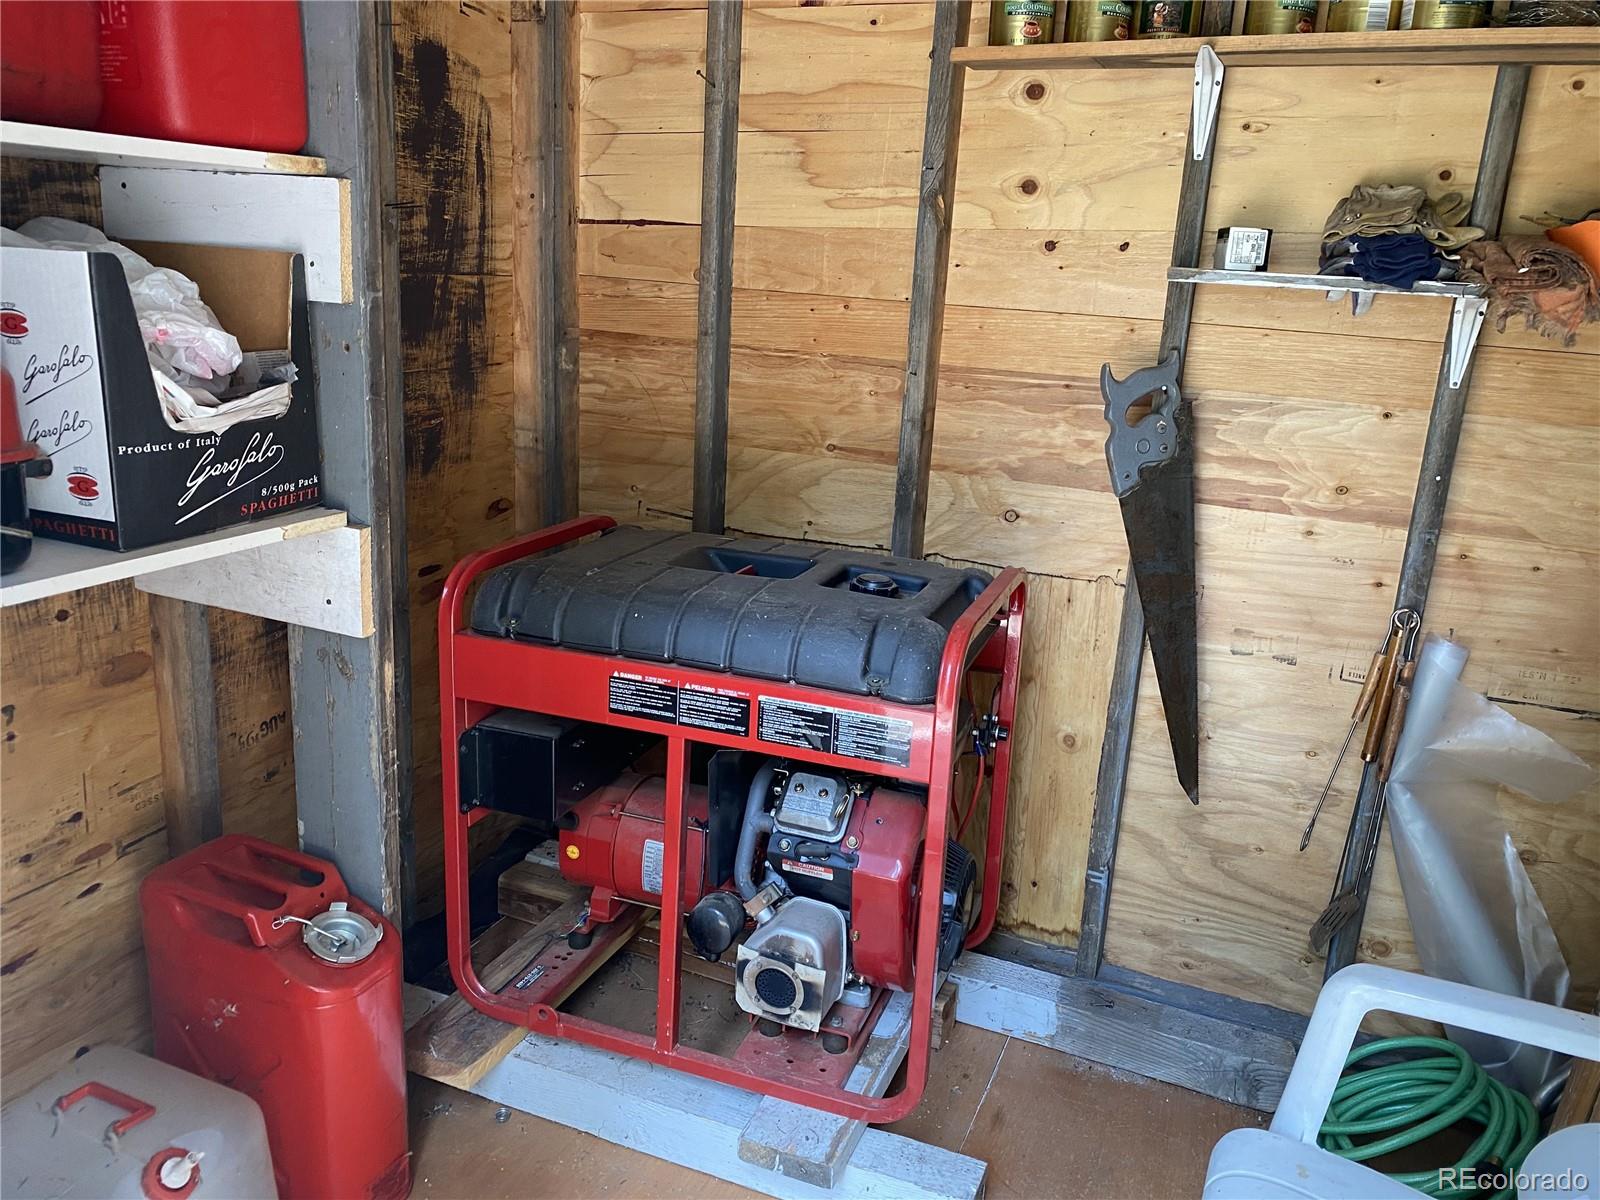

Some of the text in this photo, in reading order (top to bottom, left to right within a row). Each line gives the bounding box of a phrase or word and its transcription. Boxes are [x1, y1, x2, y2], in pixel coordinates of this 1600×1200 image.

[23, 344, 93, 398] Garofalo
[118, 435, 222, 455] Product of Italy
[176, 432, 284, 512] Garofalo
[261, 475, 319, 497] 8/500g Pack
[240, 487, 319, 516] SPAGHETTI
[620, 672, 642, 680] DANGER
[691, 684, 715, 693] PELIGRO
[799, 862, 825, 872] CAUTION
